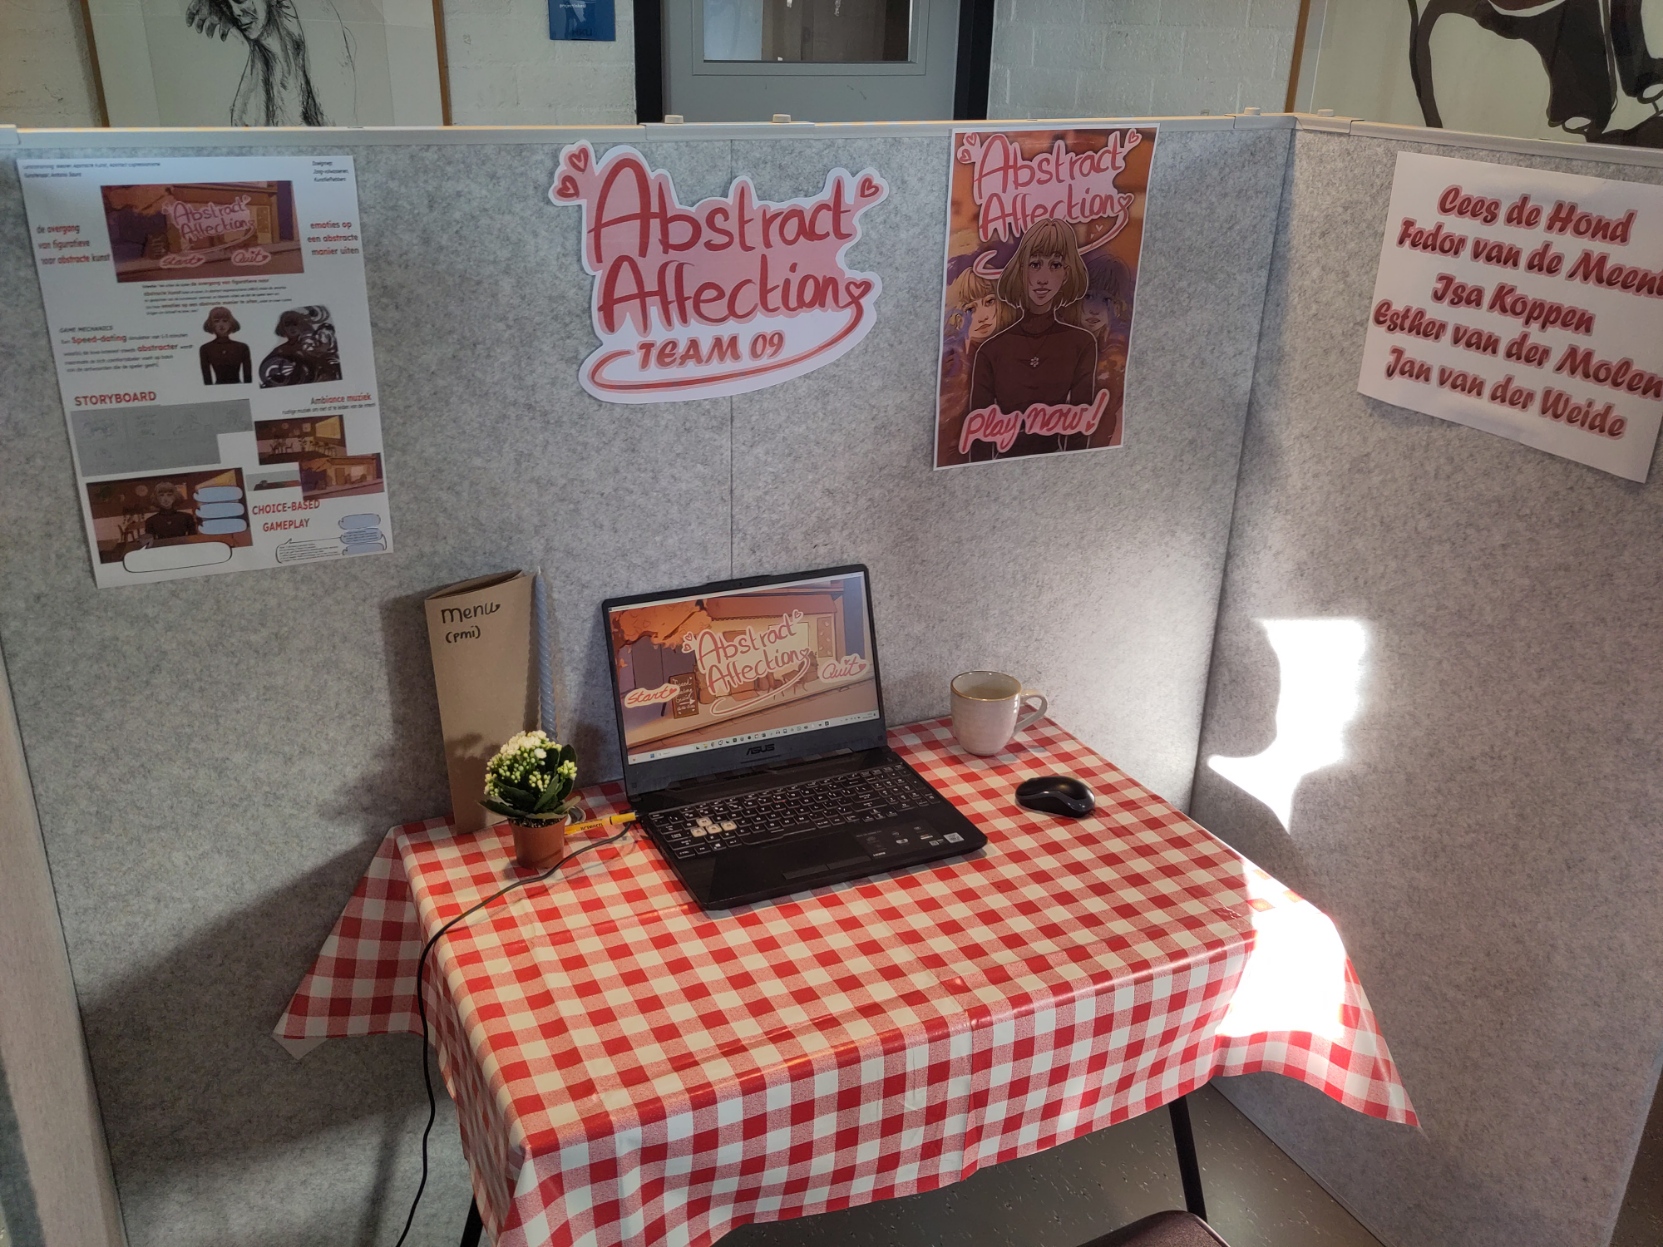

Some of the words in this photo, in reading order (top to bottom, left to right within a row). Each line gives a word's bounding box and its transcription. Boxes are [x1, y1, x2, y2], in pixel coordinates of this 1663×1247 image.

[973, 134, 1124, 199] Abstract
[173, 200, 246, 226] Abstract
[587, 158, 853, 264] Abstract
[980, 185, 1127, 241] Affection
[1438, 186, 1500, 224] Cees
[1504, 194, 1541, 227] de
[1546, 202, 1636, 244] Hond
[47, 225, 80, 236] overgang
[181, 218, 250, 239] Affection
[310, 220, 340, 230] emoties
[342, 221, 352, 230] op
[323, 234, 358, 242] abstracte
[1398, 219, 1466, 256] Fedor
[1472, 240, 1520, 268] van
[1526, 242, 1564, 274] de
[58, 255, 90, 264] abstracte
[312, 246, 338, 256] manier
[598, 254, 847, 334] Affection
[1488, 284, 1595, 334] Koppen
[72, 334, 127, 345] Speed-dating
[138, 344, 178, 352] abstracter
[1374, 301, 1446, 340] Esther
[1452, 325, 1500, 355] van
[1505, 332, 1550, 366] der
[1554, 346, 1663, 398] Molen
[638, 336, 742, 370] TEAM
[751, 332, 784, 360] 09
[74, 390, 157, 406] STORYBOARD
[310, 395, 345, 405] Ambiance
[346, 392, 372, 402] muziek
[1386, 348, 1432, 382] Jan
[1438, 366, 1485, 396] van
[1490, 376, 1534, 409] der
[1540, 386, 1626, 437] Weide
[252, 500, 320, 516] CHOICE-BASED
[262, 518, 310, 532] GAMEPLAY
[697, 615, 797, 669] Abstract
[708, 646, 800, 691] Affection
[822, 656, 863, 680] Quit
[627, 686, 674, 704] Start
[746, 744, 776, 756] ASUS
